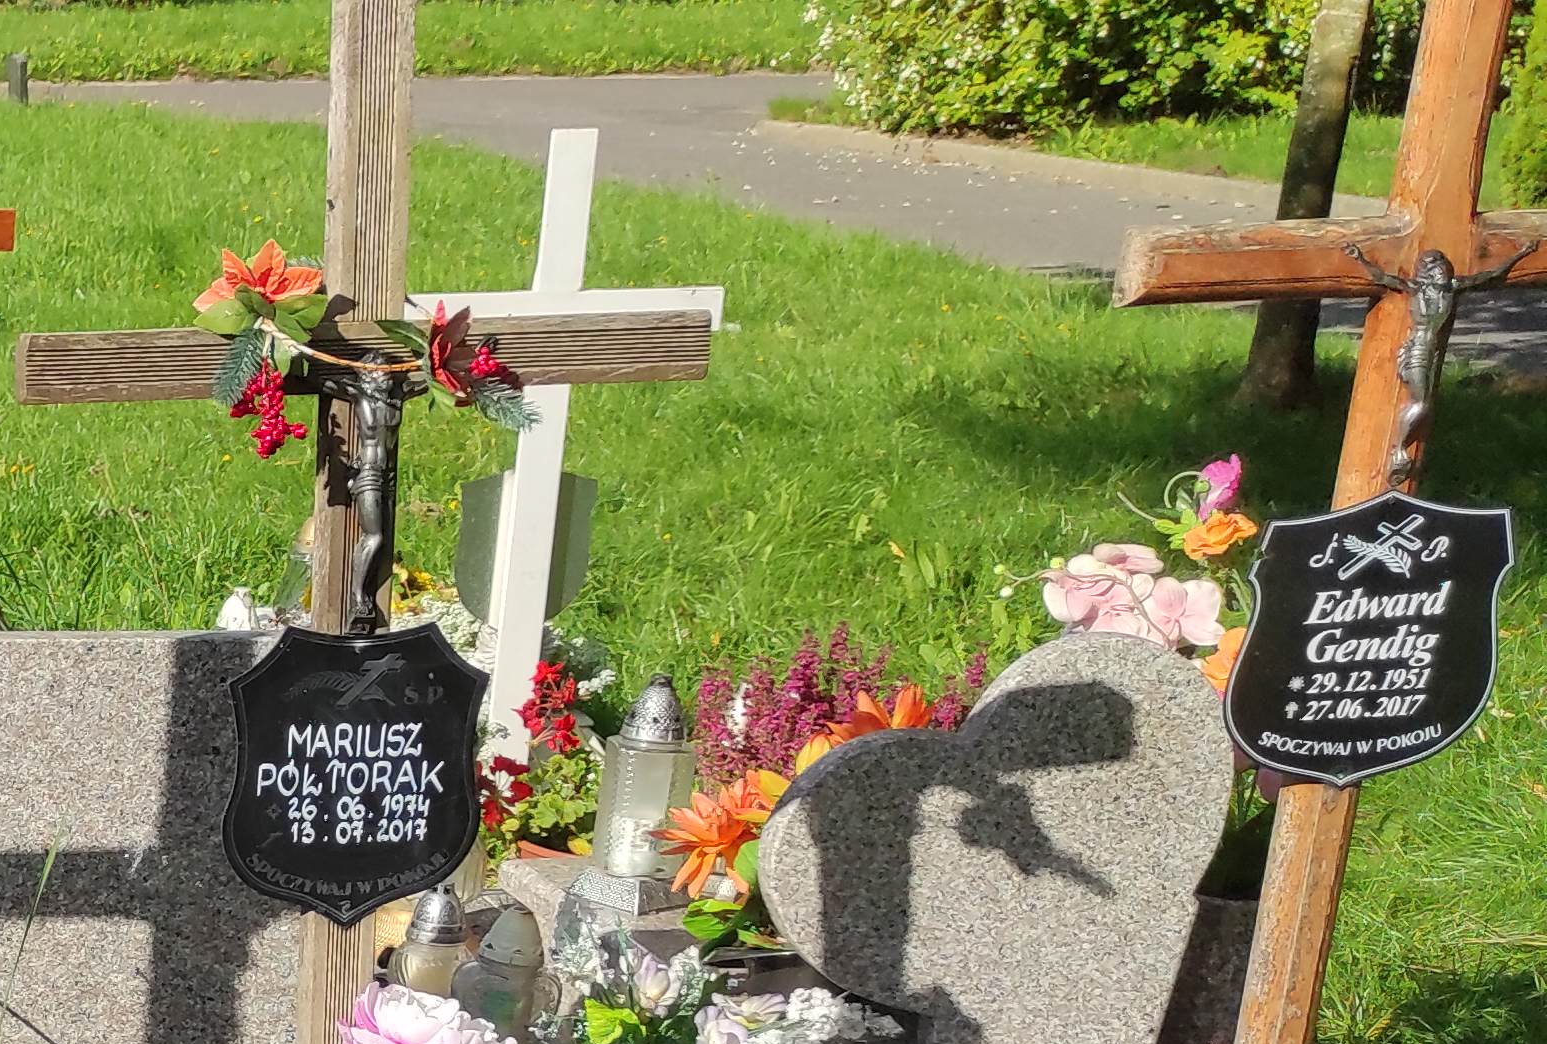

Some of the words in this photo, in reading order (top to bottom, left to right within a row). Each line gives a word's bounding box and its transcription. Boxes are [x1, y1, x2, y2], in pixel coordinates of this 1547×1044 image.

[1302, 580, 1452, 625] Edward
[1306, 623, 1440, 667] Gendig
[1305, 667, 1432, 694] 29.12.1951
[1299, 694, 1427, 721] 27.06.2017
[287, 722, 423, 758] MARIUSZ
[1257, 731, 1353, 757] SPOCZYWAJ
[1355, 739, 1374, 754] W
[1375, 722, 1442, 752] POKOJU
[245, 852, 352, 897] SPOCZYWAJ
[356, 880, 374, 895] W
